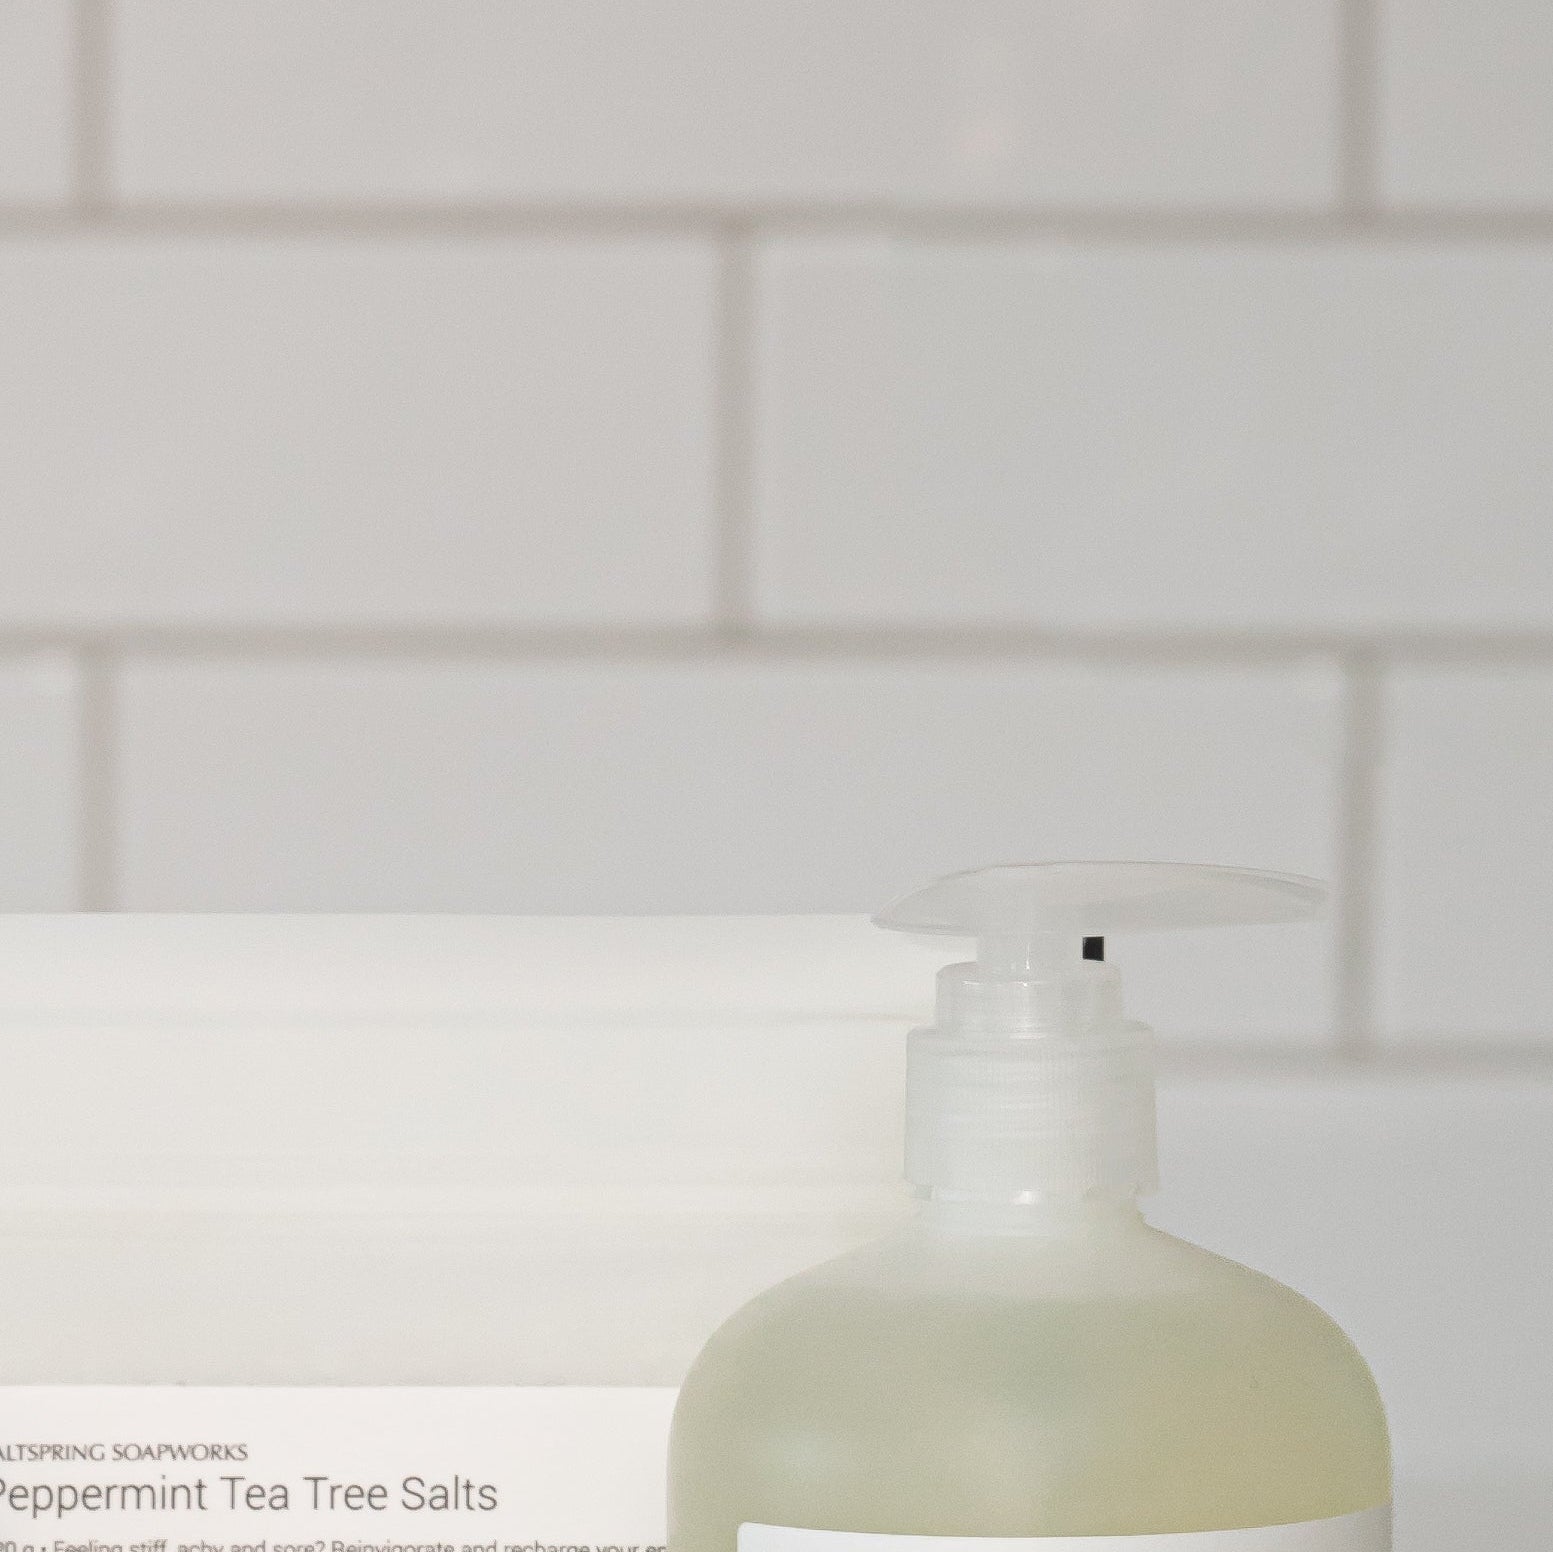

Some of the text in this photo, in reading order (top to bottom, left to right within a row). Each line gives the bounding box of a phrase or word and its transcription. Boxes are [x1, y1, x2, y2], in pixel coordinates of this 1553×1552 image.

[112, 1443, 248, 1461] SOAPWORKS
[219, 1476, 289, 1510] Tea
[302, 1476, 387, 1511] Tree
[401, 1474, 497, 1511] Salts
